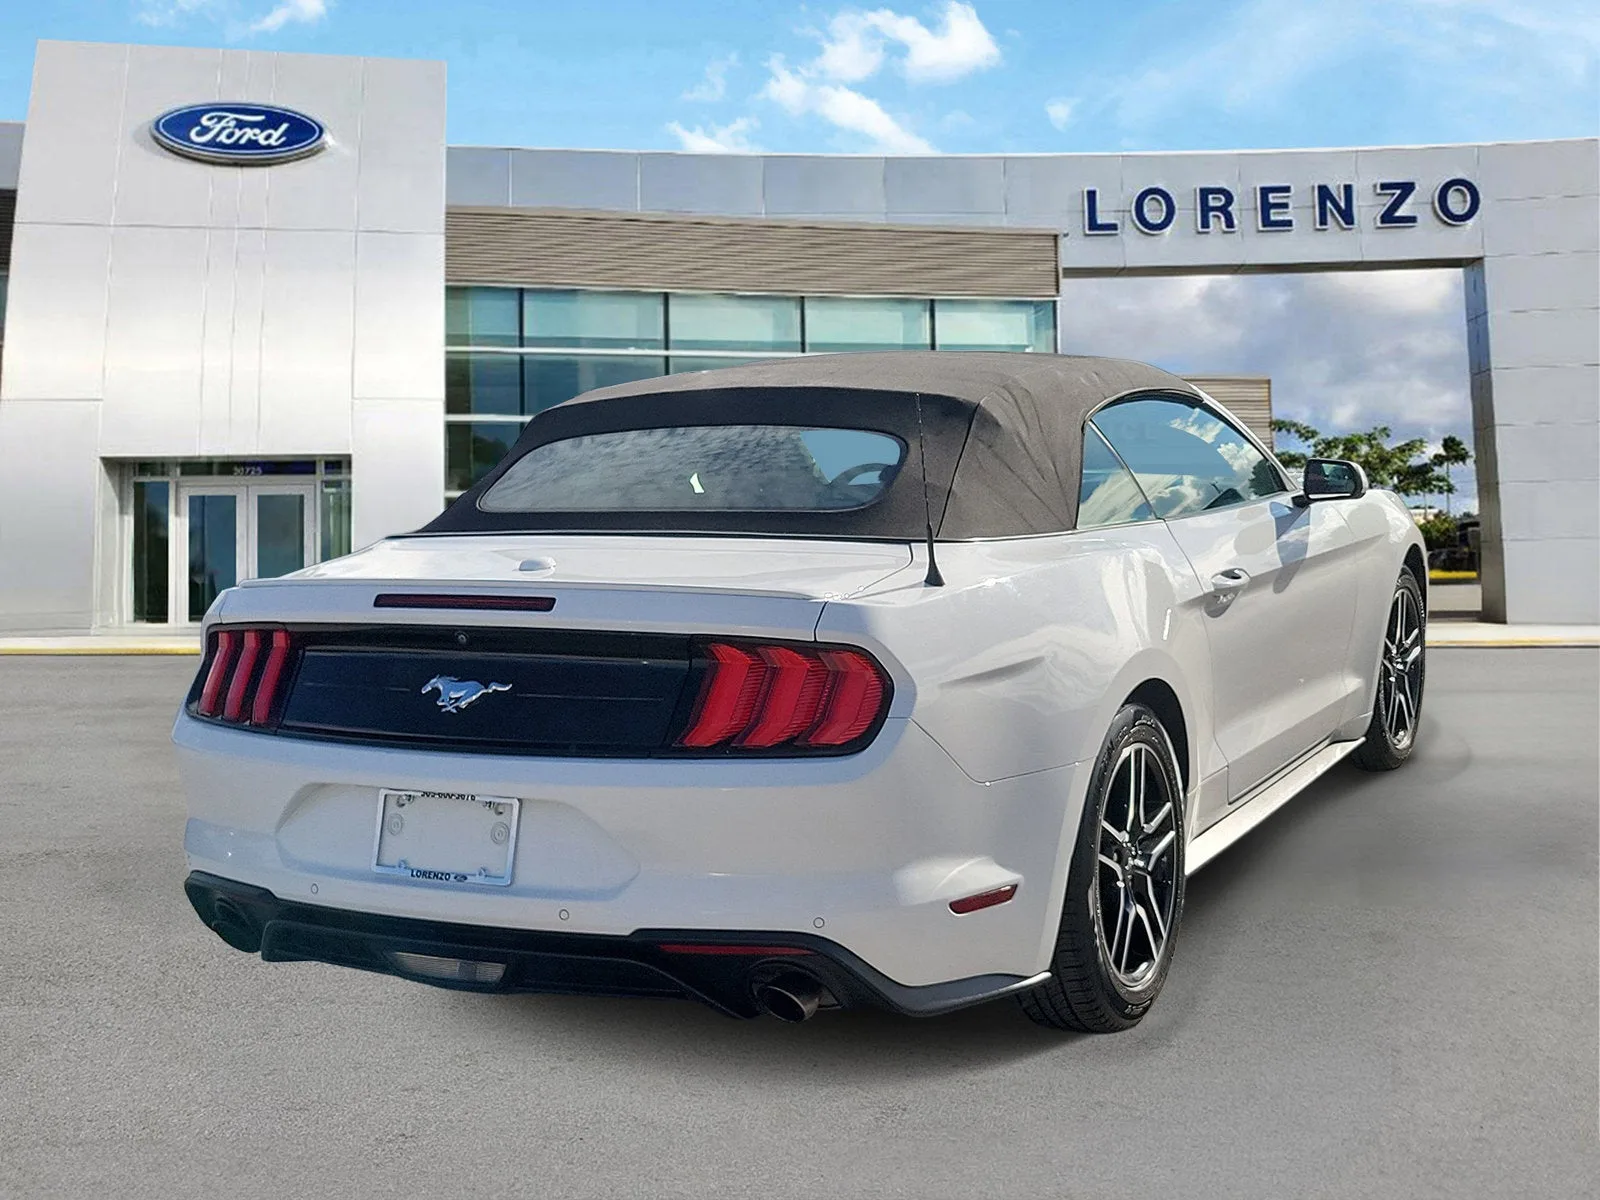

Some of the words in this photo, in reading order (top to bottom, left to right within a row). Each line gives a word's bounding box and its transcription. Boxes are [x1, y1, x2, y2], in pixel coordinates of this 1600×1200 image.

[189, 111, 290, 147] Ford
[1083, 178, 1481, 235] LORENZO
[410, 869, 451, 881] LORENZO
